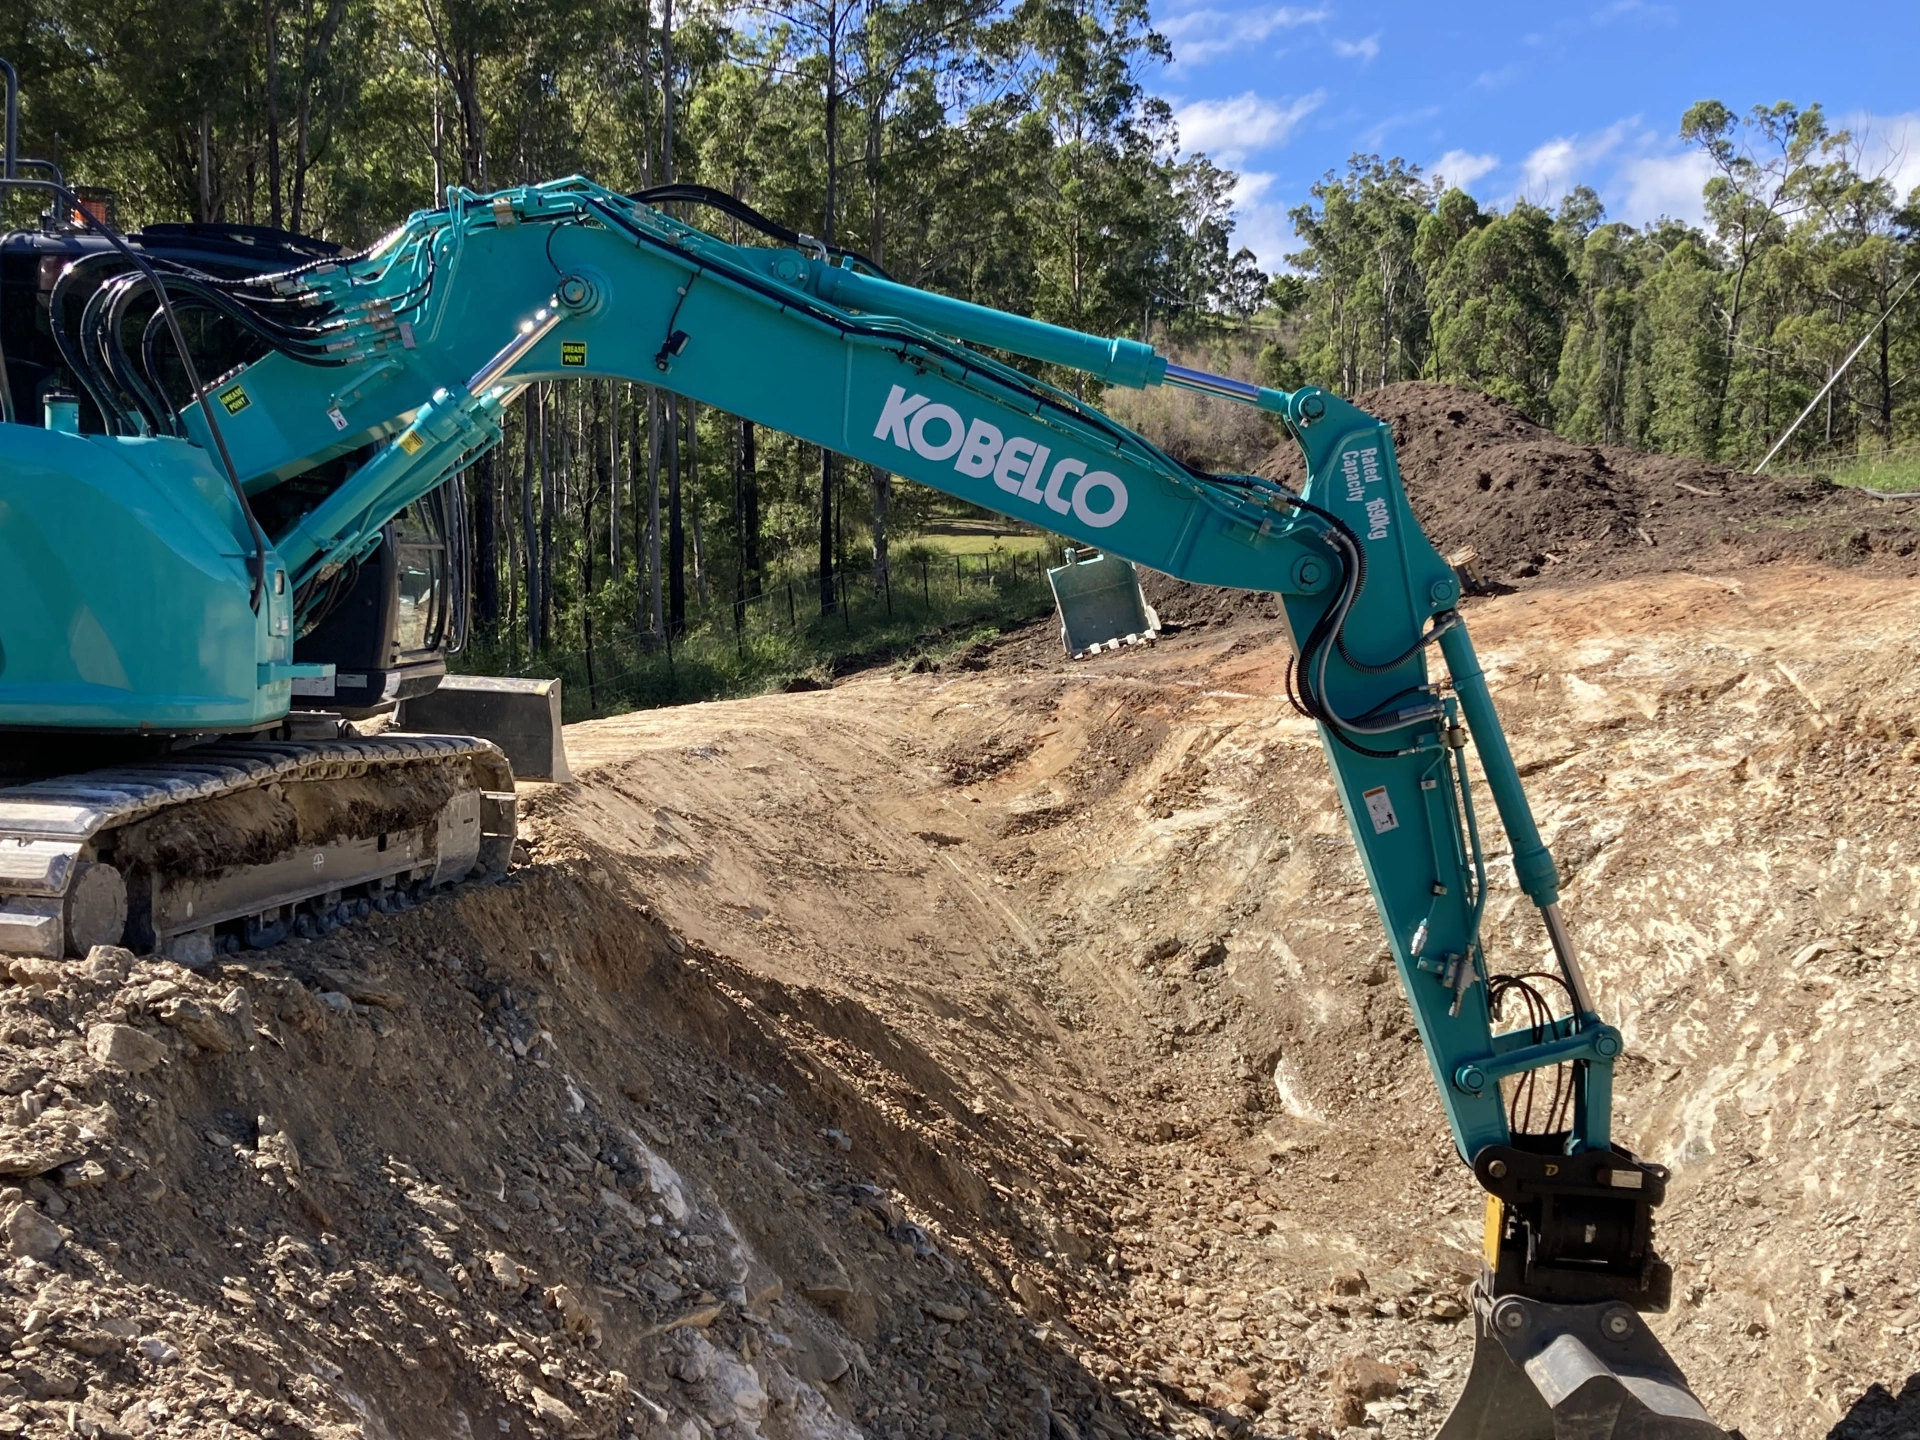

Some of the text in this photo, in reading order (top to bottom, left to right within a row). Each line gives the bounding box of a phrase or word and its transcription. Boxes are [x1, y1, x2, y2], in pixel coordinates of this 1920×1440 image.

[563, 345, 585, 353] GREASE
[565, 355, 582, 363] POINT
[221, 387, 244, 404] GREASE
[228, 396, 246, 411] POINT
[873, 384, 1129, 528] KOBELCO
[1360, 447, 1382, 483] Rated
[1341, 451, 1365, 502] Capacity
[1365, 497, 1390, 540] 1690kg
